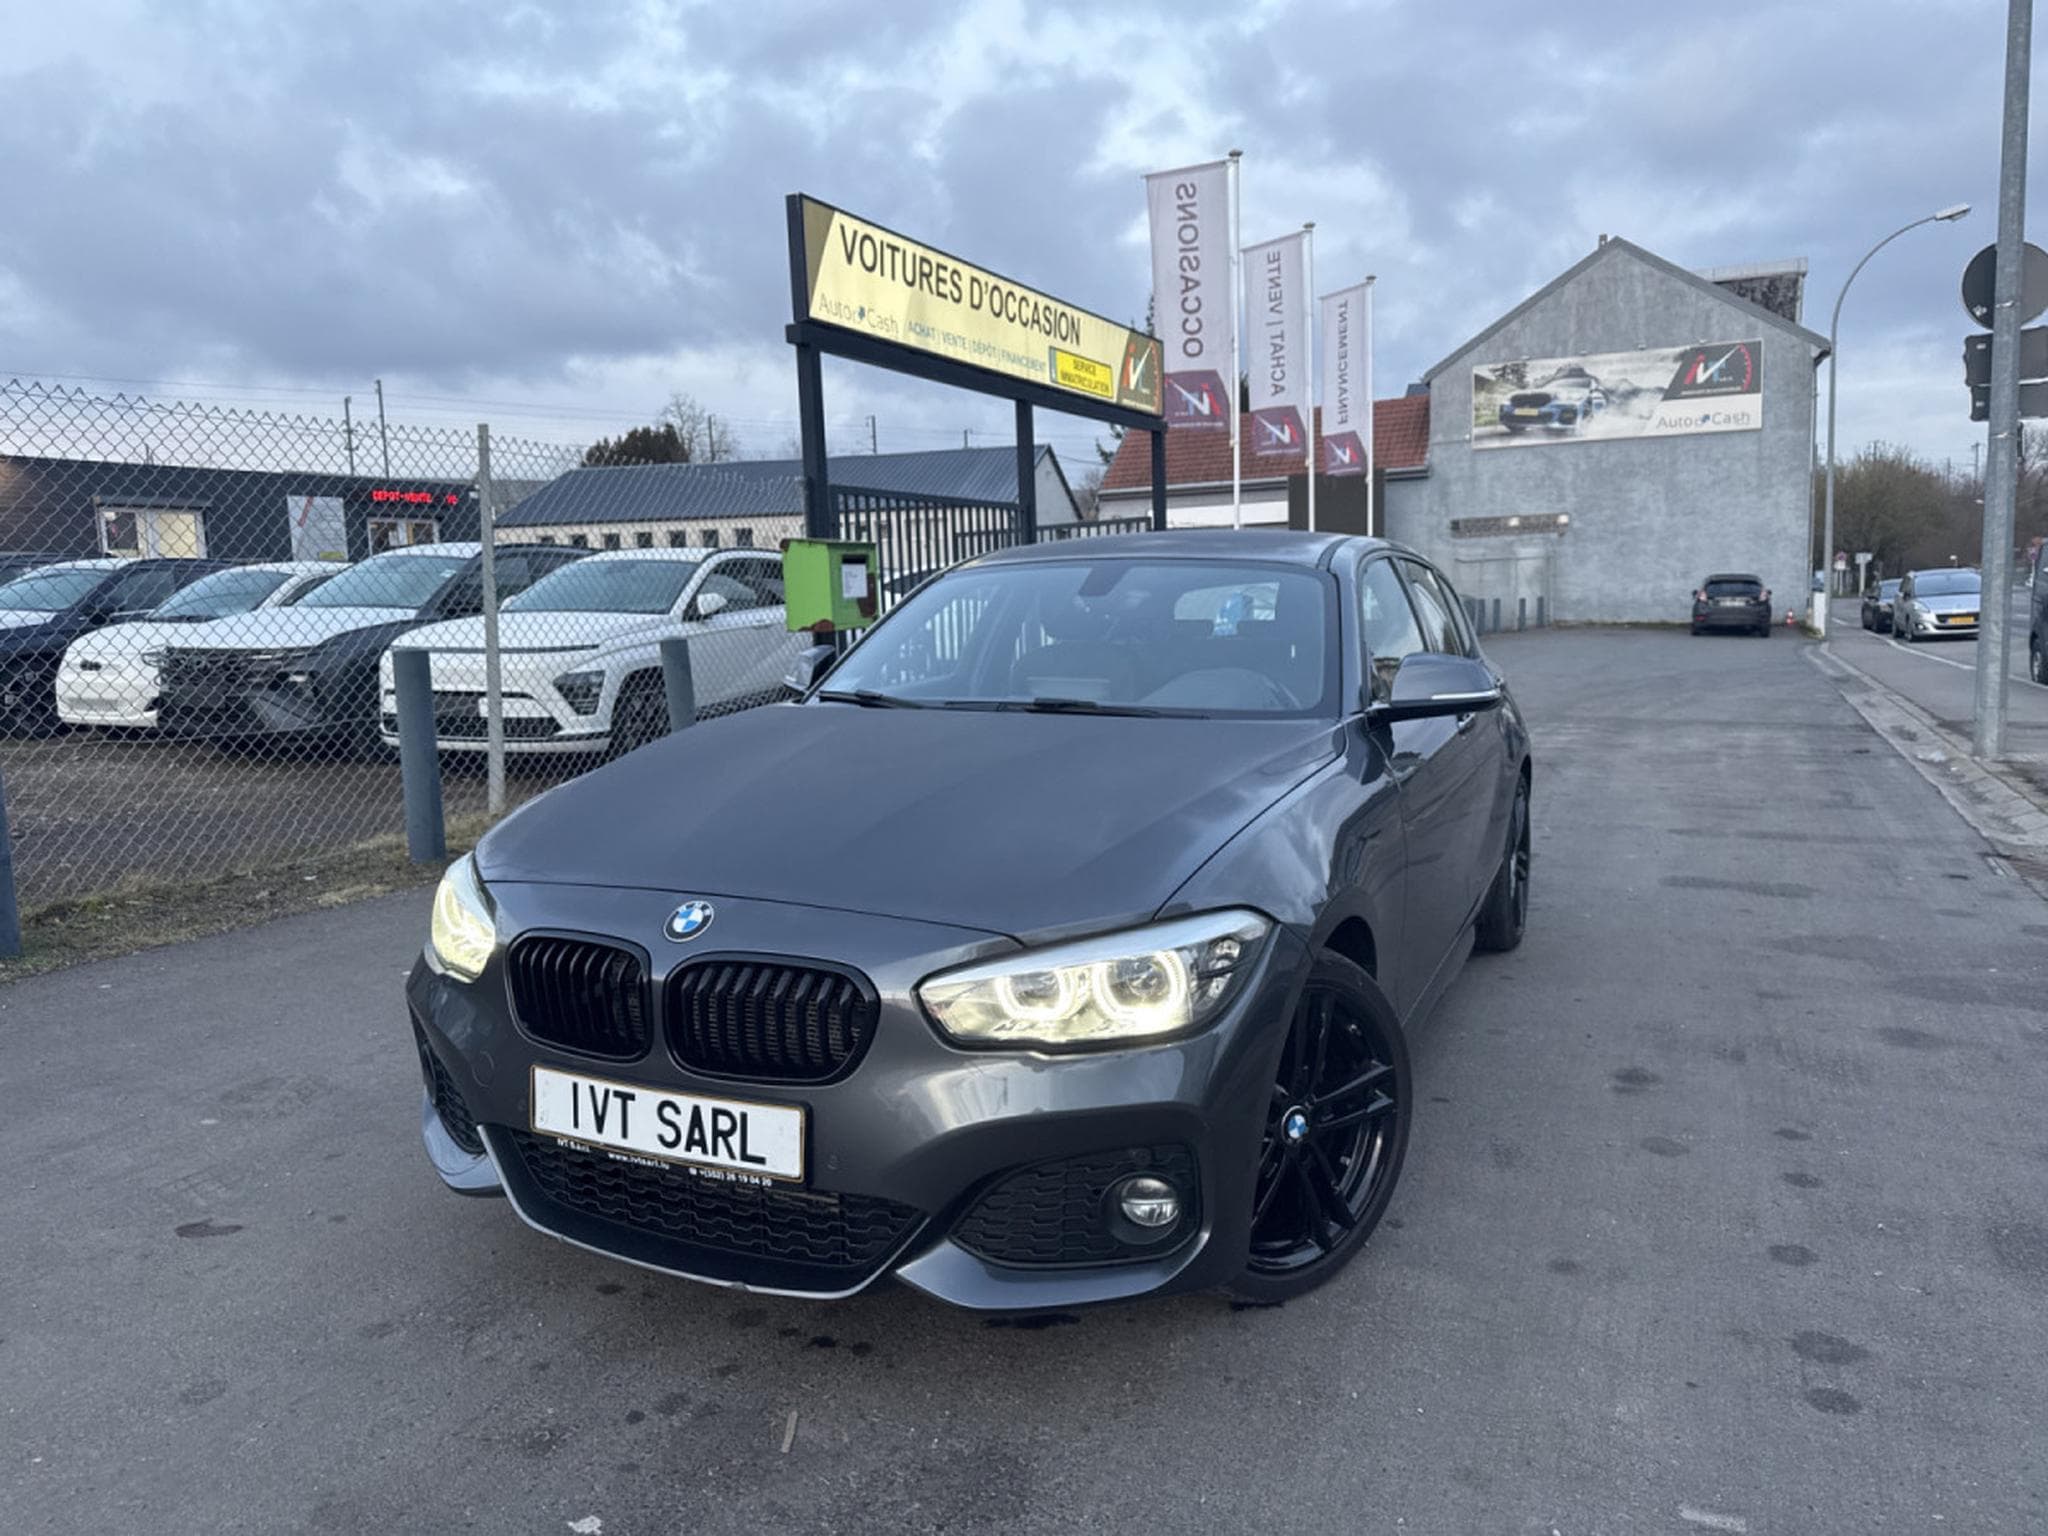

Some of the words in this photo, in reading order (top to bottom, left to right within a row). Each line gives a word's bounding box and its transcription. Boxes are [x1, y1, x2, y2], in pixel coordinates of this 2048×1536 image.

[839, 224, 962, 303] VOITURES
[970, 276, 1081, 346] D'OCCASION
[656, 1100, 766, 1165] SARL
